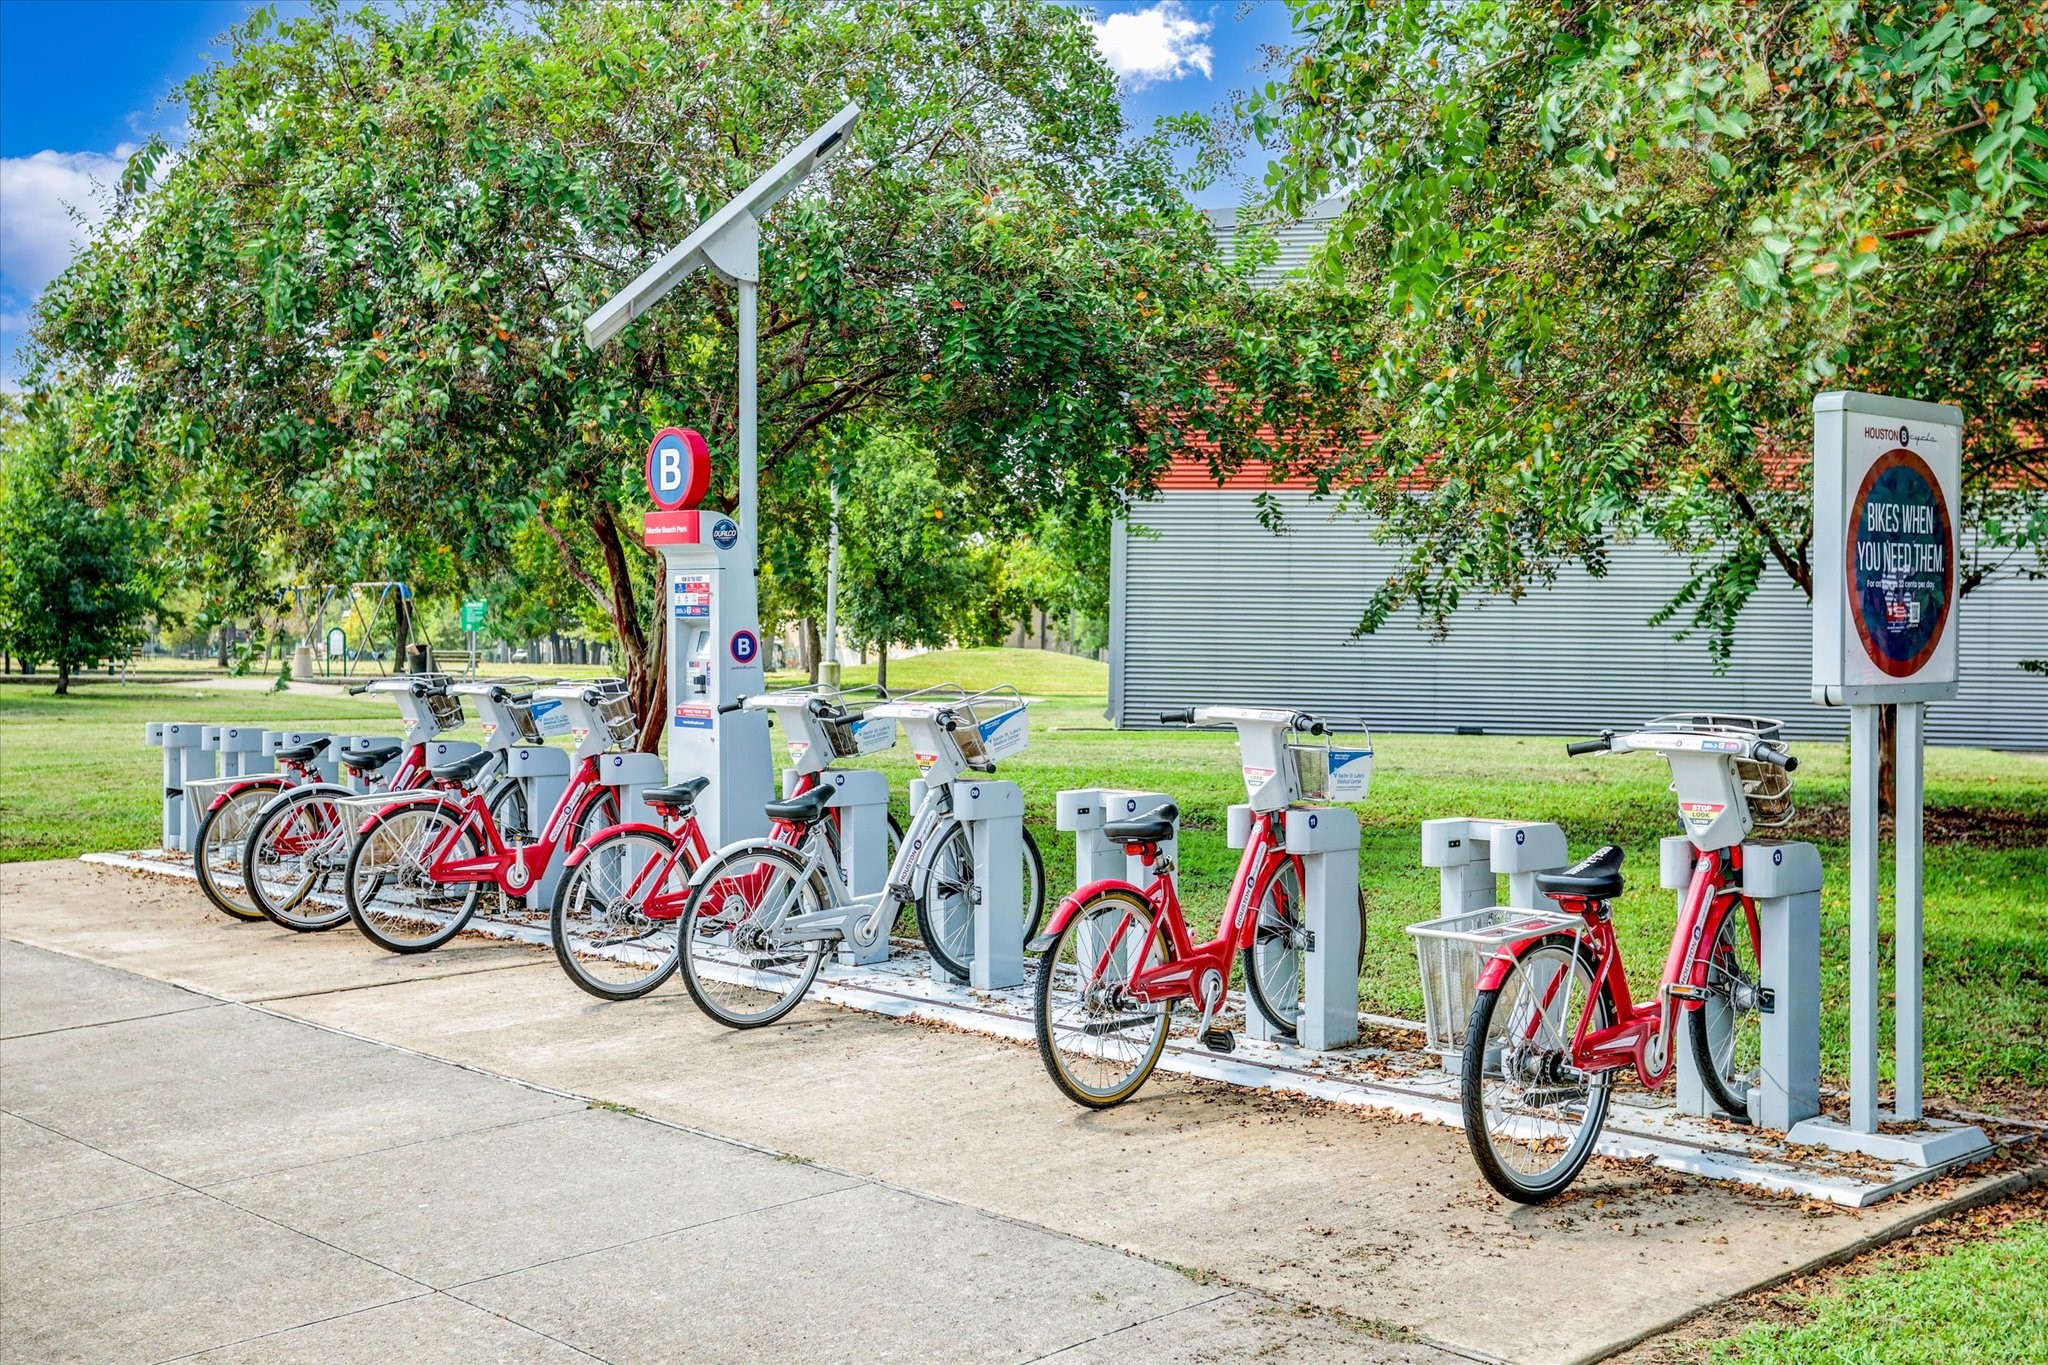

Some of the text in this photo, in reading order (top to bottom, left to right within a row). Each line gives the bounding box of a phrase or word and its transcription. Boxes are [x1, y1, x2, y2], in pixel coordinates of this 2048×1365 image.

[1864, 426, 1898, 441] HOUSTON
[660, 448, 682, 491] B
[1867, 502, 1934, 534] BIKES WHEN
[1857, 541, 1944, 573] YOU NEED THEM.
[1866, 580, 1875, 588] For
[738, 638, 750, 656] B
[900, 850, 917, 882] HOUSTON
[1775, 852, 1780, 862] 13
[1236, 888, 1251, 926] HOUSTON
[1681, 940, 1698, 986] HOUSTON
